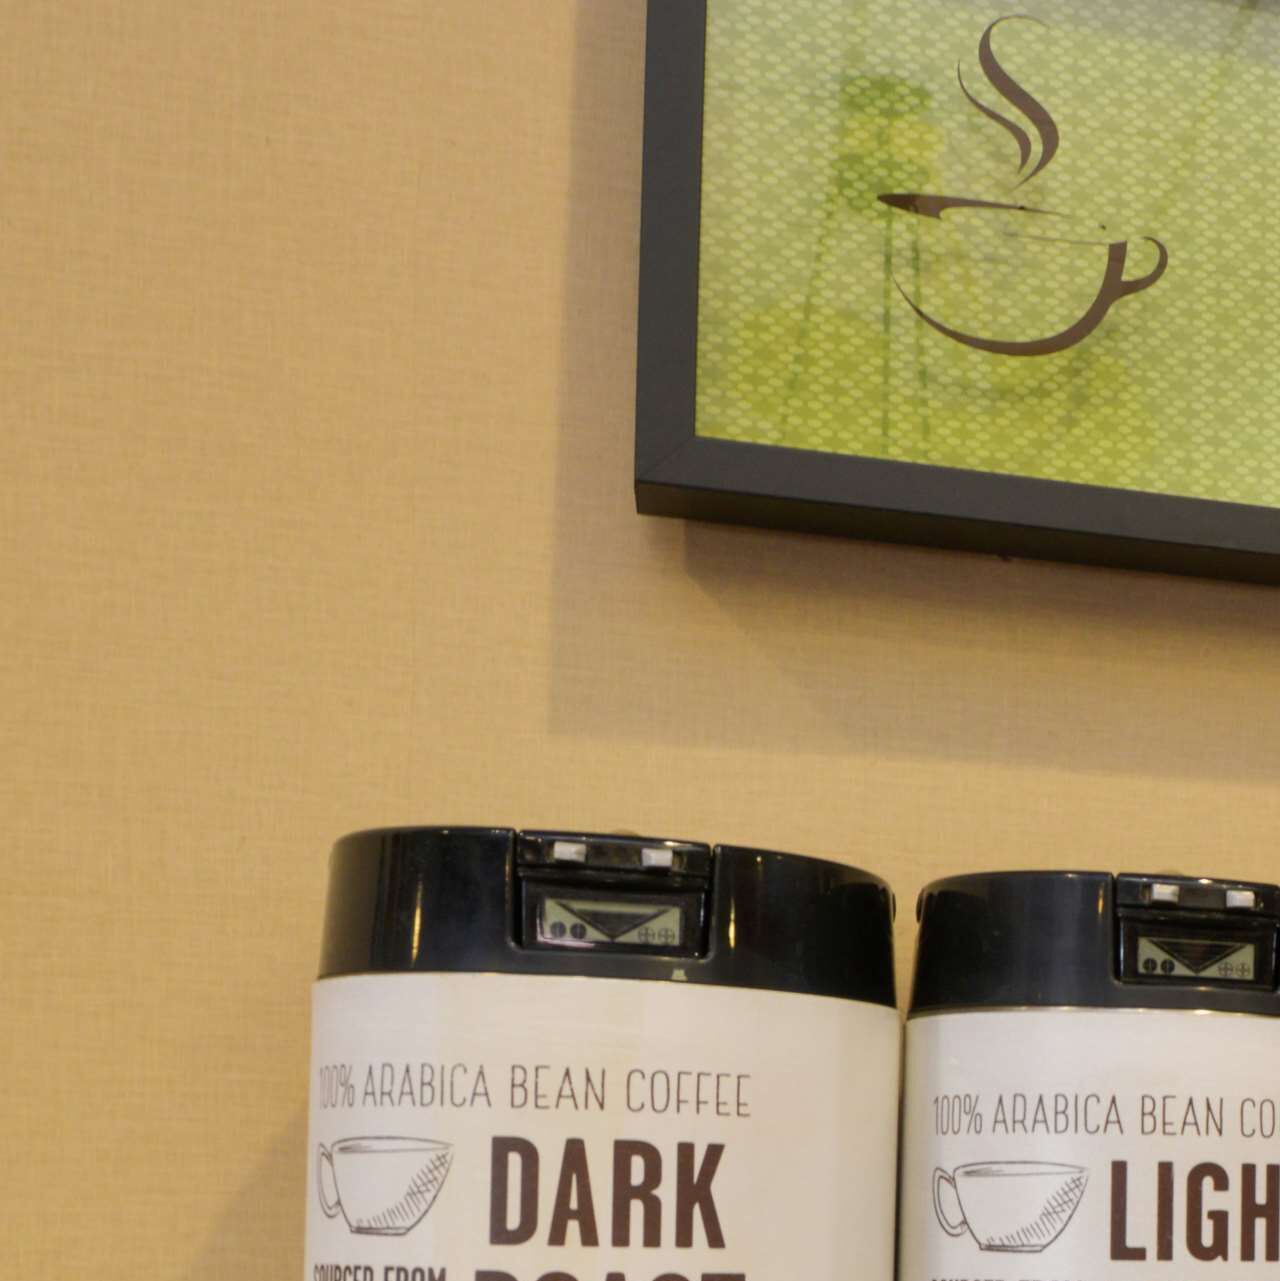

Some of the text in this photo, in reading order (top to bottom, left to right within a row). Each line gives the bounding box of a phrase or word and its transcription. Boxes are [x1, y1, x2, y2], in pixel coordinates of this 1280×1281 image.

[318, 1062, 752, 1118] 100% ARABICA BEAN COFFEE
[933, 1093, 984, 1136] 100%
[991, 1092, 1125, 1136] ARABICA
[1140, 1094, 1225, 1137] BEAN
[488, 1135, 727, 1250] DARK
